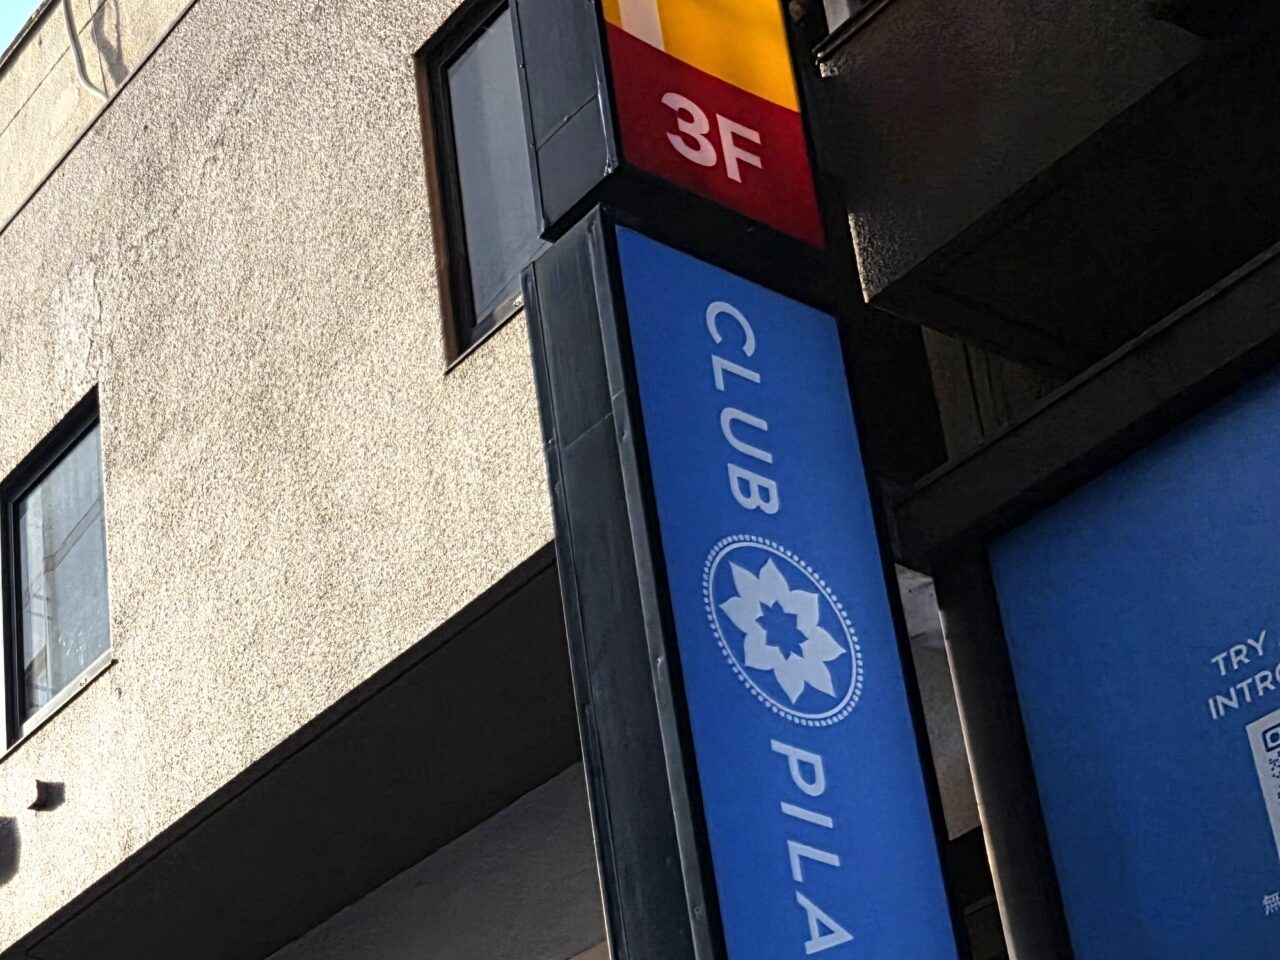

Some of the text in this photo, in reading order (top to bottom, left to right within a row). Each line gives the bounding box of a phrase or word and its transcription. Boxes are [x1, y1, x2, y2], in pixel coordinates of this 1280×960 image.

[660, 91, 763, 184] 3F
[705, 300, 780, 515] CLUB
[1211, 629, 1266, 676] TRY
[1208, 663, 1280, 720] INTR
